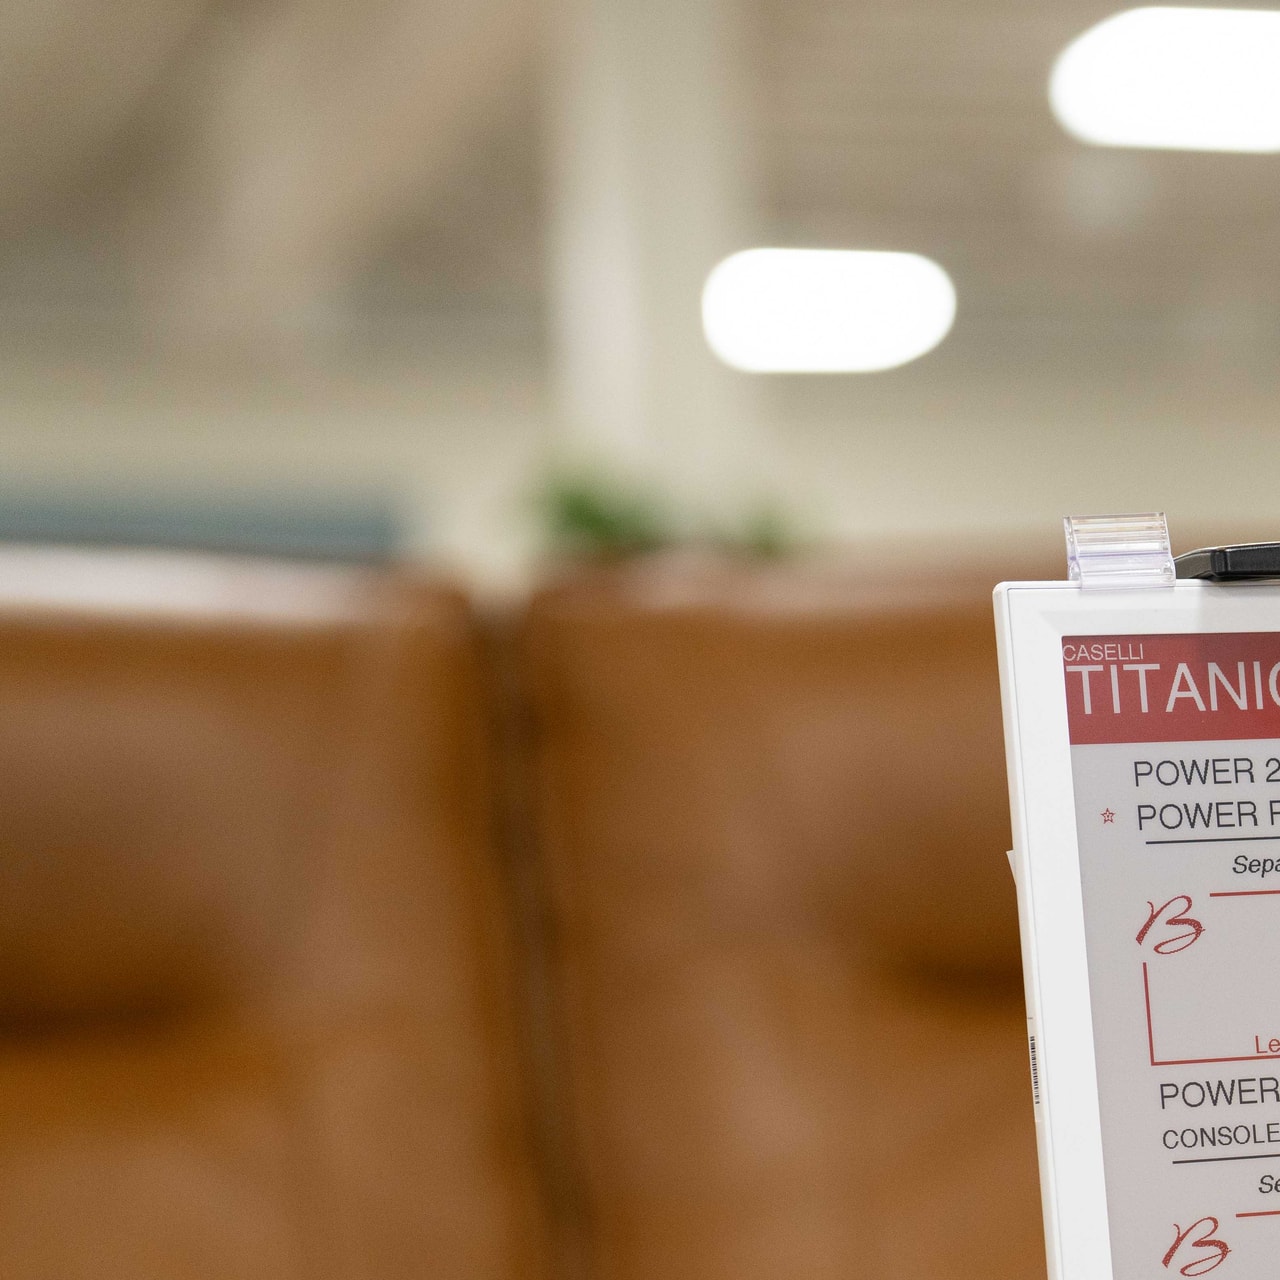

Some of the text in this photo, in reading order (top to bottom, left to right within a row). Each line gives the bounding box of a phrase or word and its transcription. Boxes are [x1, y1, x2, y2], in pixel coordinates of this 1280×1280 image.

[1062, 643, 1144, 662] CASELLI
[1134, 758, 1254, 787] POWER
[1138, 801, 1258, 830] POWER
[1160, 1077, 1280, 1109] POWER
[1163, 1123, 1280, 1149] CONSOLE
